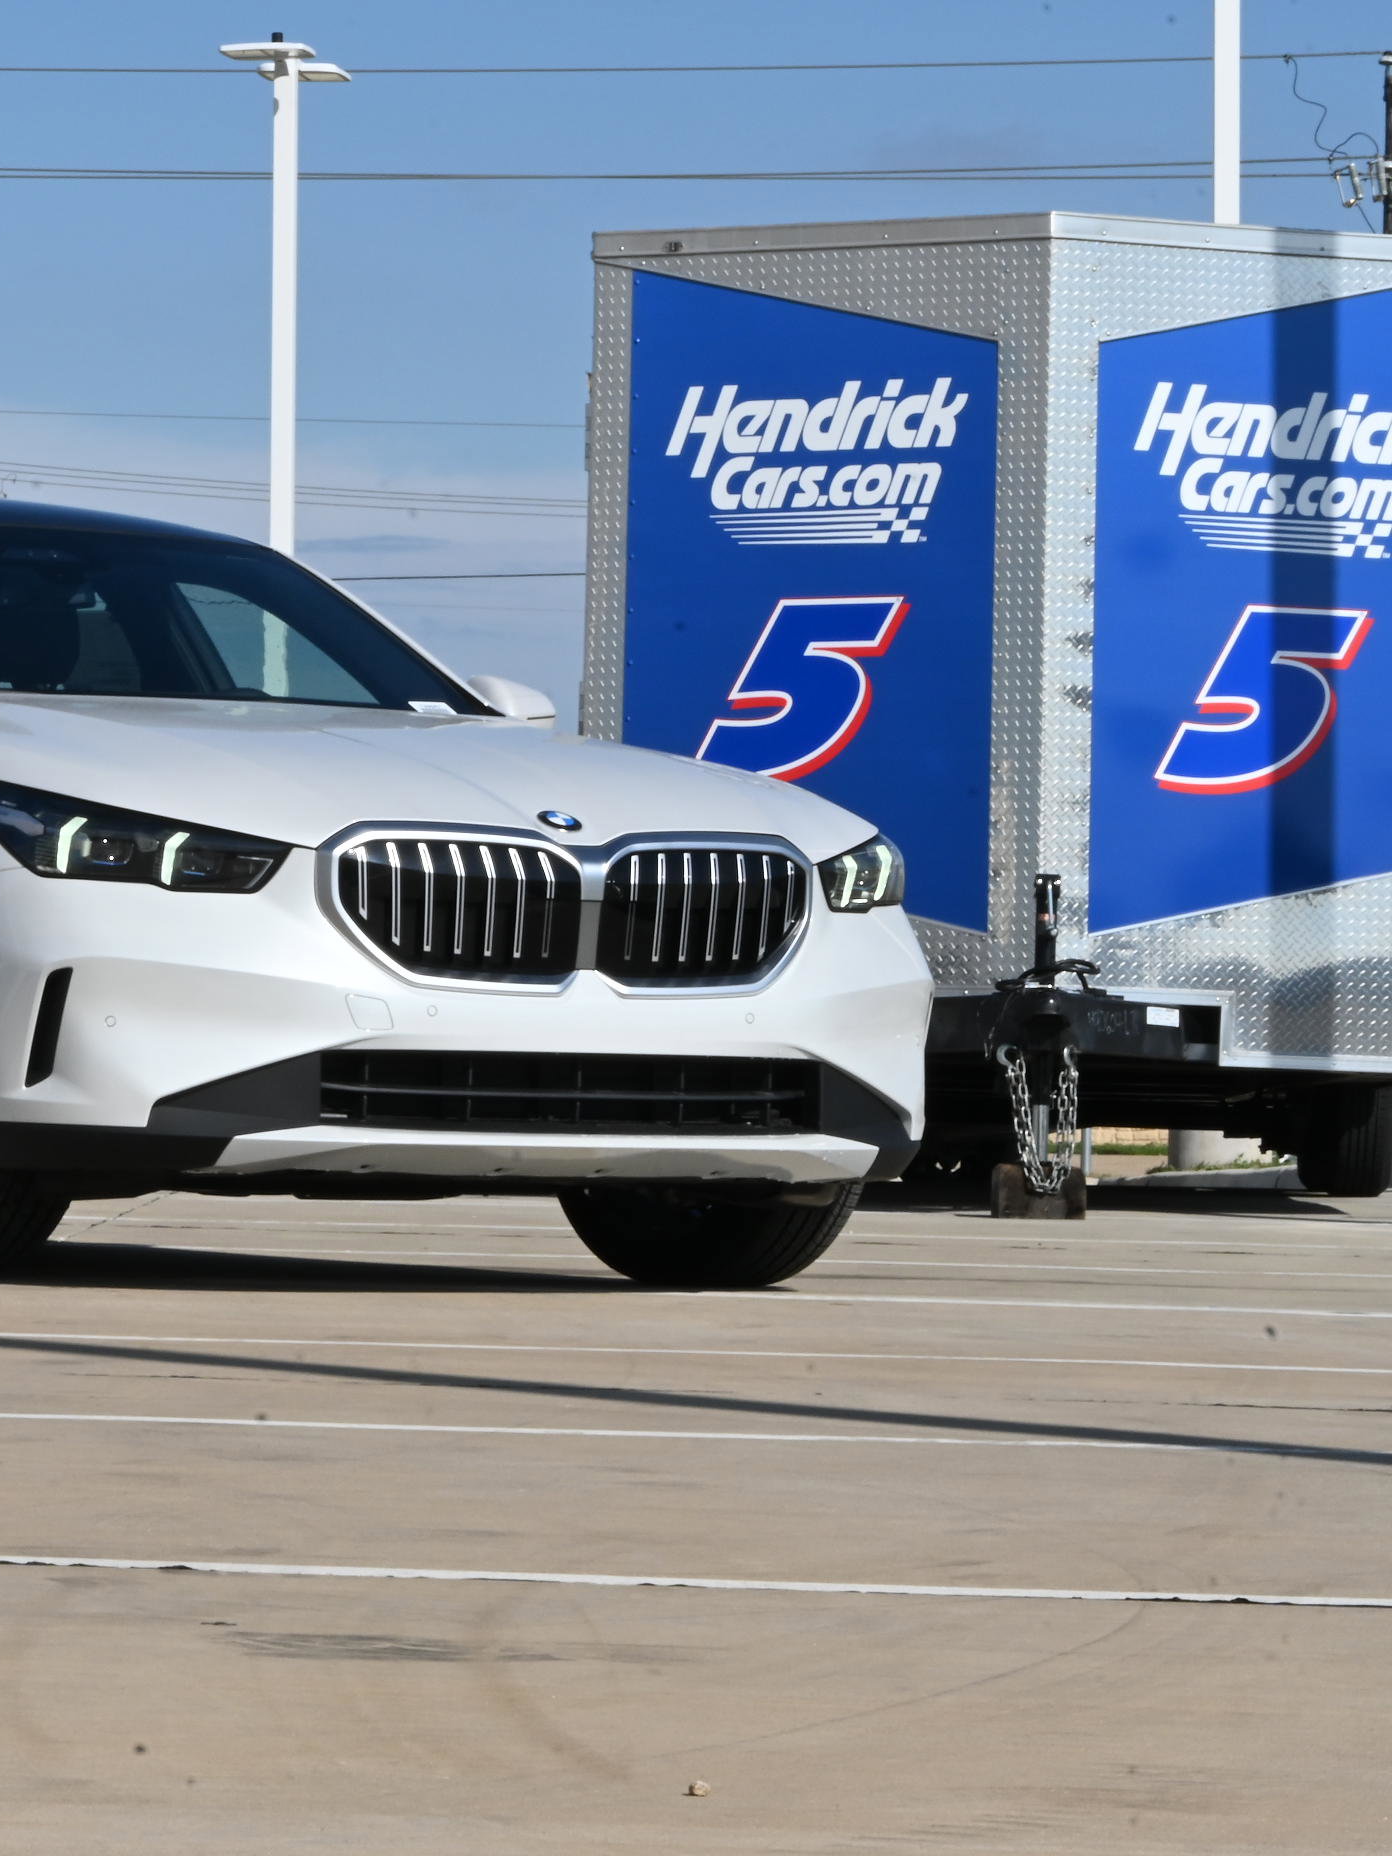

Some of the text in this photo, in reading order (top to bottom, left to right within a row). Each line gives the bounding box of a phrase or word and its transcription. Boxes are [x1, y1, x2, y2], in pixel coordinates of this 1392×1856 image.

[665, 376, 969, 478] Hendrick
[1133, 381, 1392, 477] Hendric
[710, 455, 943, 510] Cars.com
[1179, 457, 1392, 521] Cars.com
[695, 595, 911, 783] 5
[1153, 604, 1375, 795] 5
